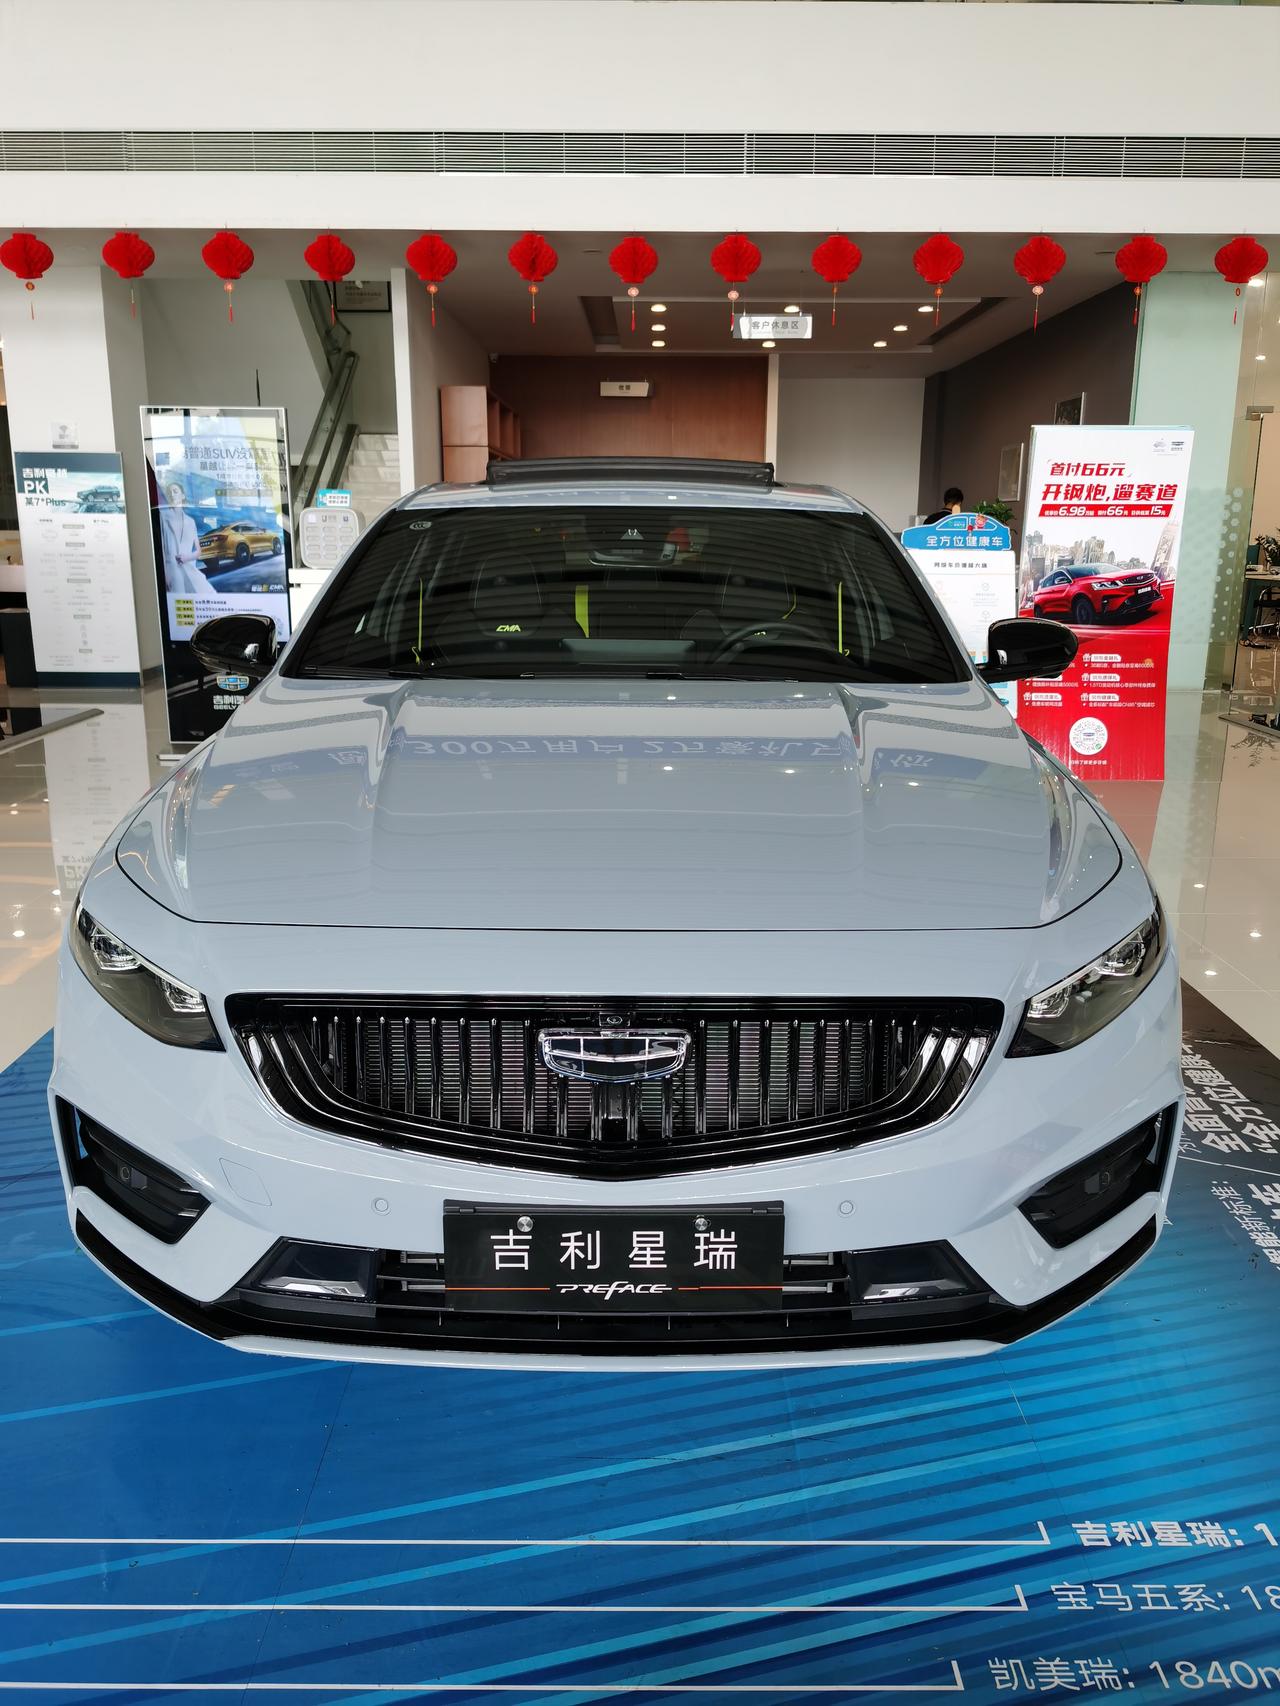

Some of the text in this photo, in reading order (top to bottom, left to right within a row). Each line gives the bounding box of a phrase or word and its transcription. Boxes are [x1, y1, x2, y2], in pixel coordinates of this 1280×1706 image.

[751, 320, 799, 330] 客户休息区
[1049, 462, 1126, 477] 首付66元
[23, 480, 47, 495] PK
[926, 535, 1004, 547] 全方位健康车
[495, 624, 521, 632] CMA
[490, 1229, 738, 1271] 吉利星瑞
[556, 1281, 673, 1300] PREFACE
[1071, 1520, 1245, 1547] 吉利星瑞:
[1050, 1581, 1230, 1611] 宝马五系:
[988, 1656, 1135, 1691] 凯美瑞:
